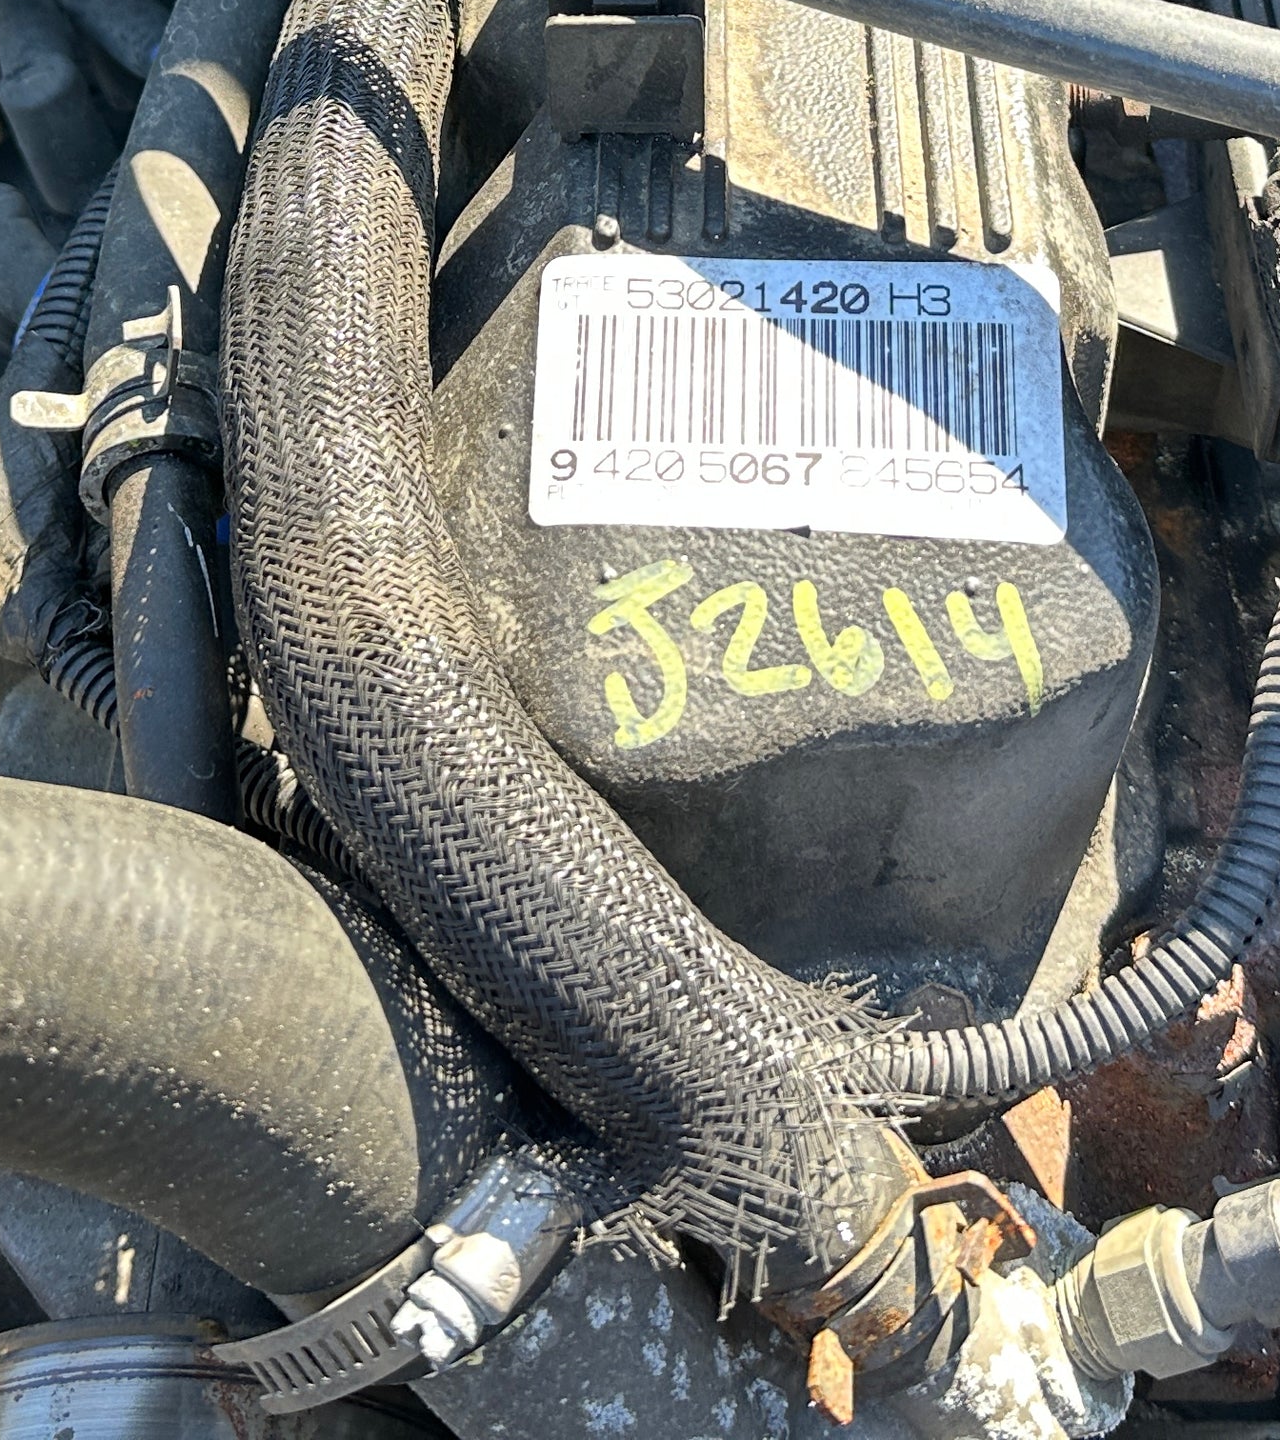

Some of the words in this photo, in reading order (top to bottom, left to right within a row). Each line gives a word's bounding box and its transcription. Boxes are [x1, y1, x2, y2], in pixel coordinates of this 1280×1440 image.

[627, 277, 870, 314] 53021420
[889, 282, 952, 316] H3
[550, 448, 578, 481] 9
[593, 448, 685, 481] 420
[699, 451, 823, 486] 5067
[588, 559, 1044, 748] J2614
